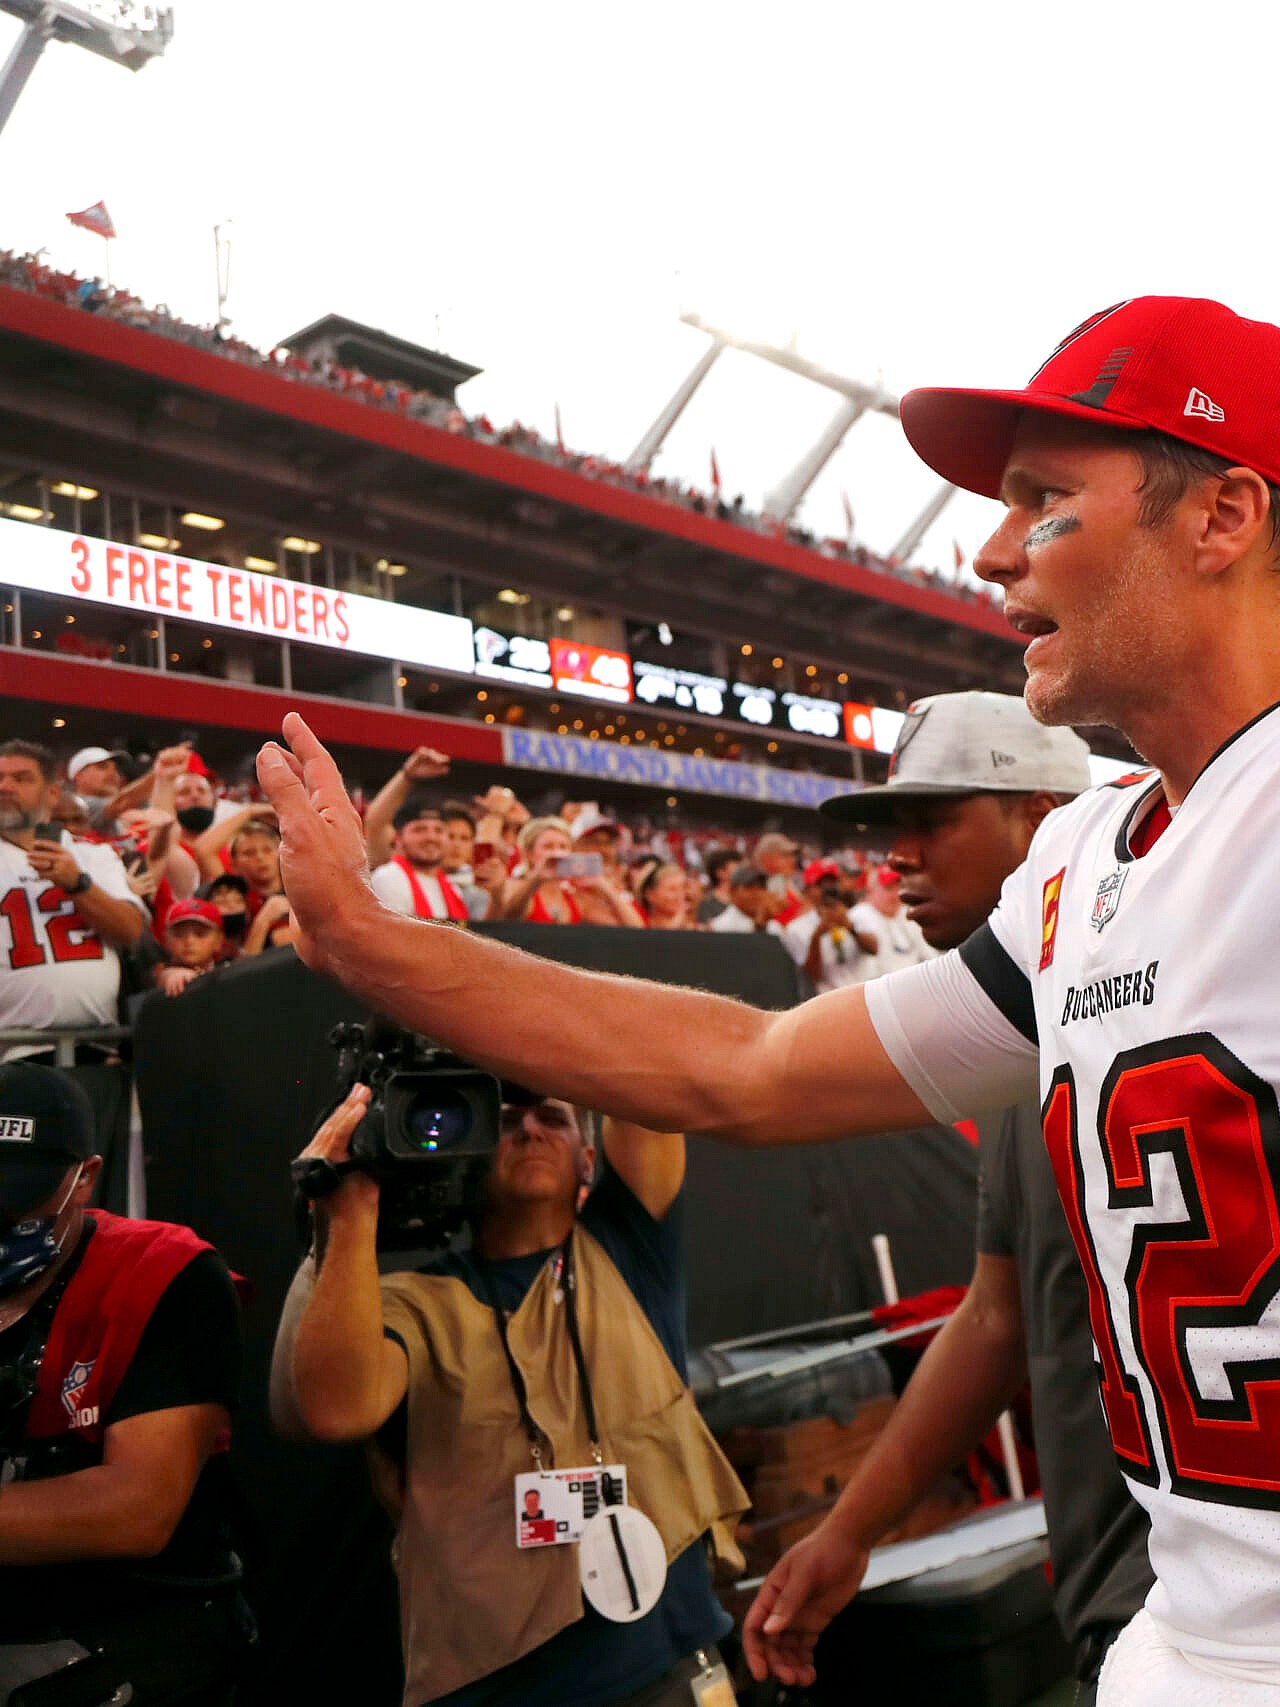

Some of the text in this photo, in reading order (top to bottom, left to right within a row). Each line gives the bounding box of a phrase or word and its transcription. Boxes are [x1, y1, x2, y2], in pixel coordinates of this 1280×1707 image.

[70, 537, 350, 643] 3 FREE TENDERS
[511, 729, 670, 784] RAYMOND
[673, 755, 761, 797] JAMES
[0, 886, 105, 971] 12
[1092, 890, 1114, 919] NFL
[1060, 960, 1160, 1027] BUCCANEERS
